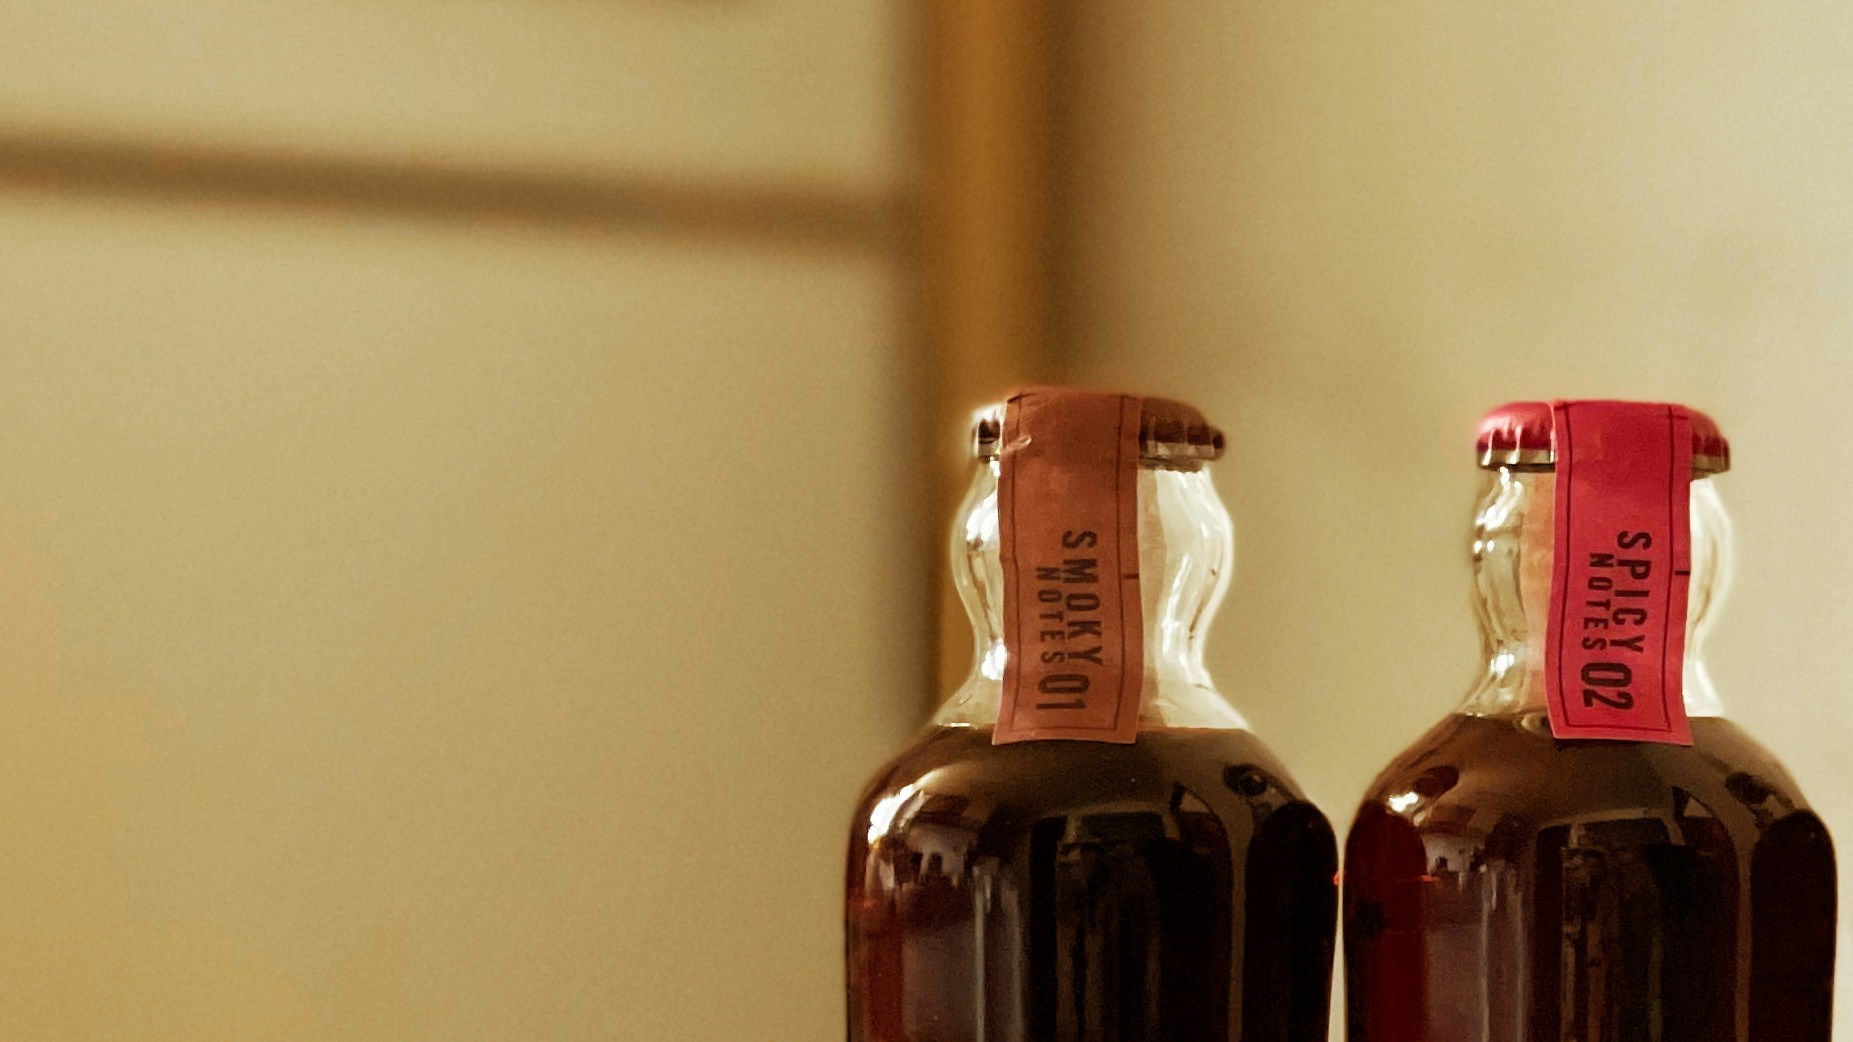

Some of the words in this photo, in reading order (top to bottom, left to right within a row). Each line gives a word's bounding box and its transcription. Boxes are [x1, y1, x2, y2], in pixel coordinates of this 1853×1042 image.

[1035, 567, 1065, 664] NOTES
[1062, 530, 1103, 665] SMOKY
[1581, 552, 1614, 651] NOTES
[1609, 530, 1652, 654] SPICY
[1036, 674, 1090, 710] 01
[1580, 662, 1634, 710] 02
